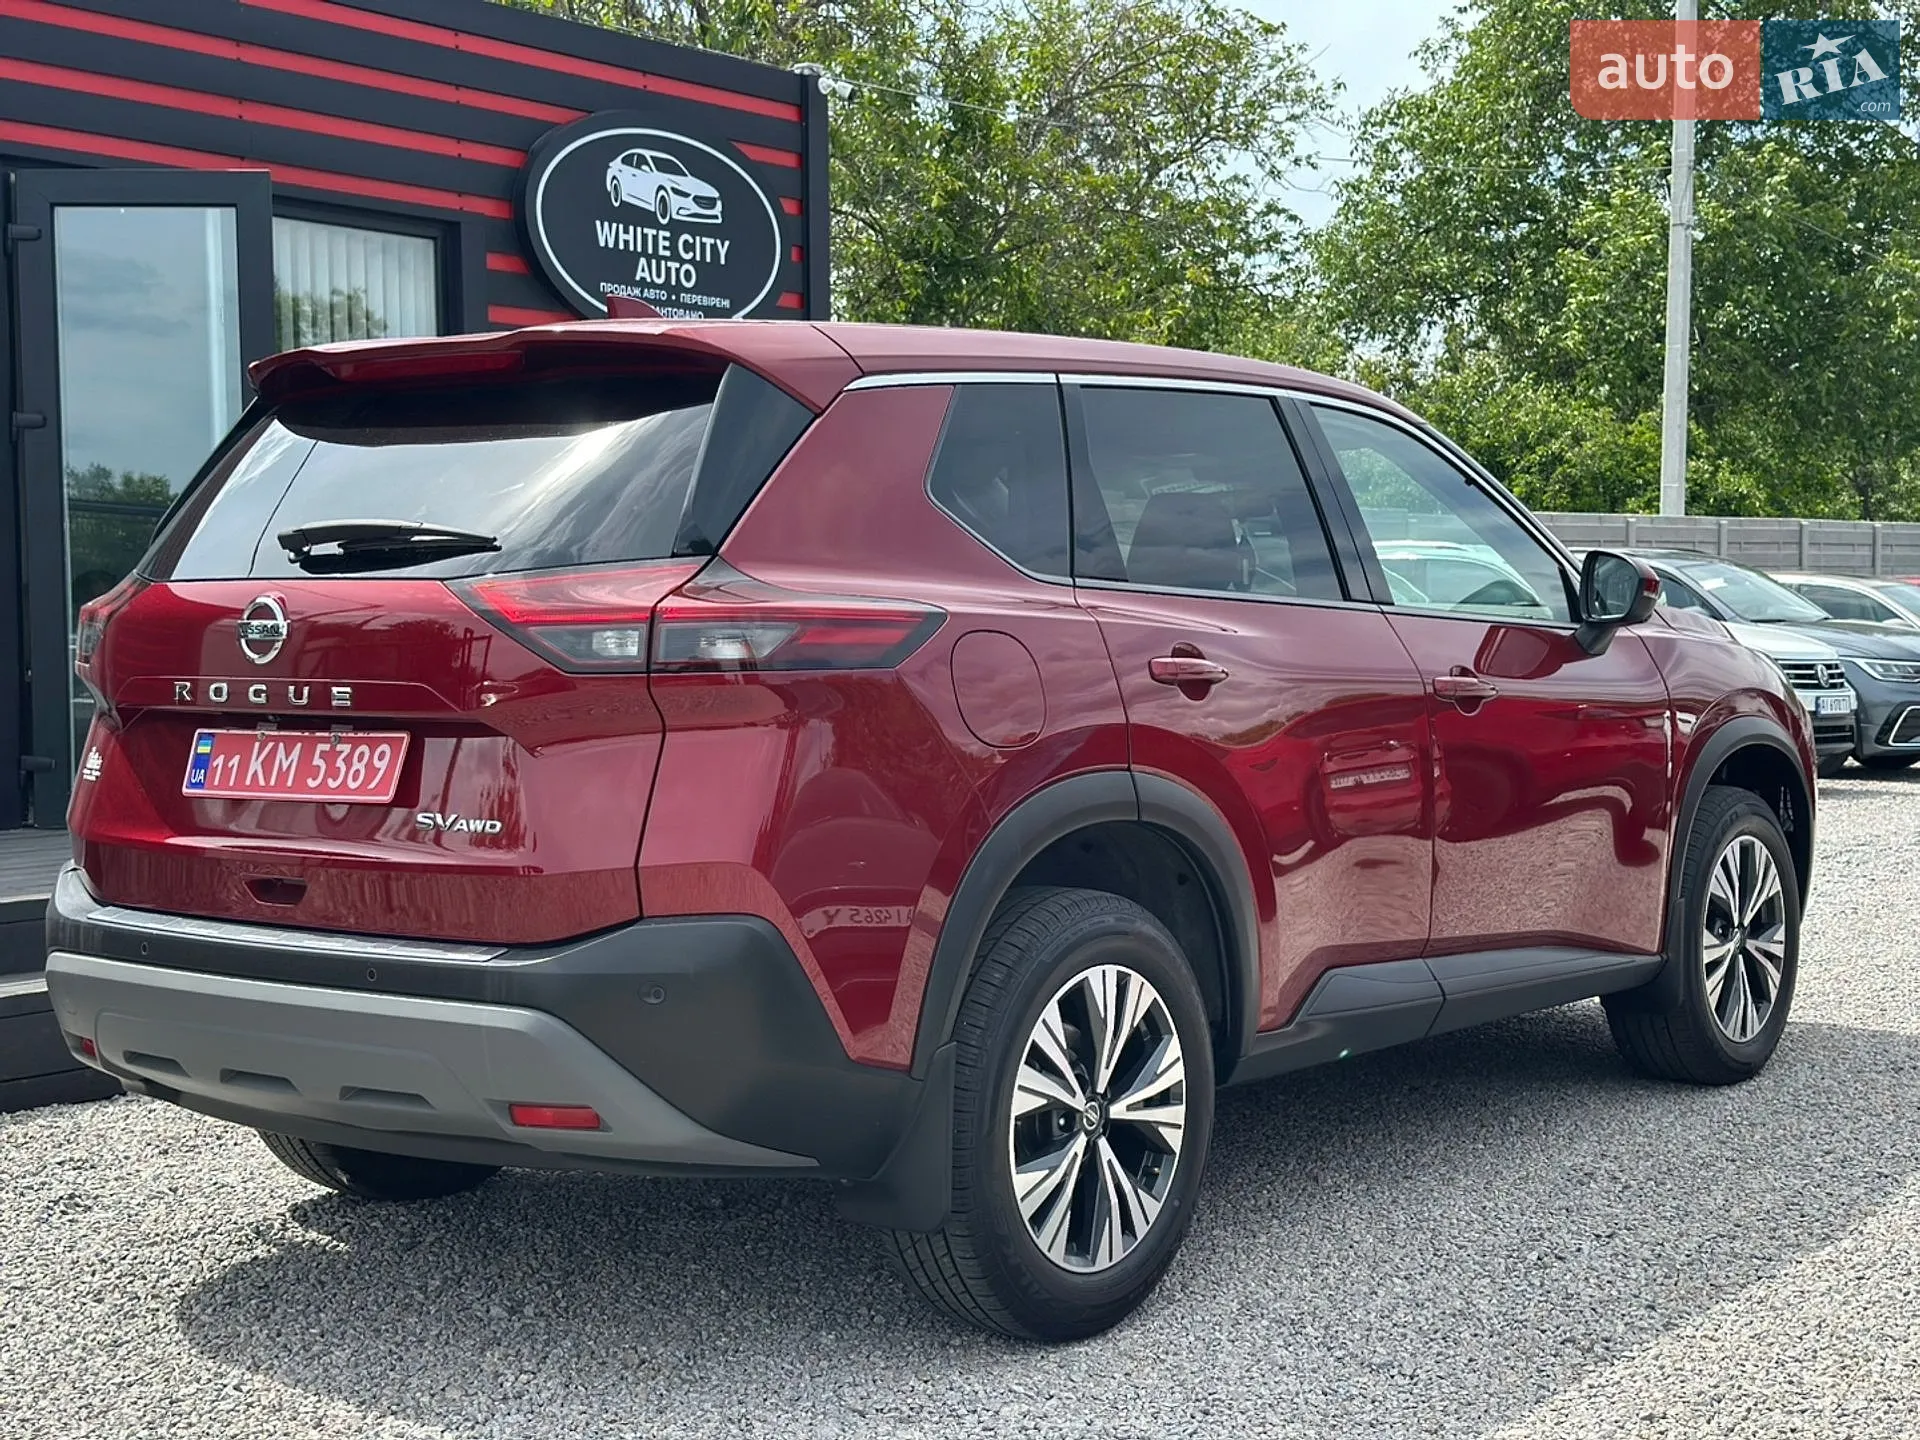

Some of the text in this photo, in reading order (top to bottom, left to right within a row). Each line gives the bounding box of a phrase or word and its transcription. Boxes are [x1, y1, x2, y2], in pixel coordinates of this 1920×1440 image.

[595, 220, 730, 265] WHITE CITY
[635, 257, 697, 288] AUTO
[600, 282, 730, 309] ПРОДАЖ АВТО ПЕРЕВІРЕНІ
[174, 681, 352, 707] ROGUE
[190, 742, 392, 790] UA 11 KM 5389
[454, 819, 502, 834] AWD
